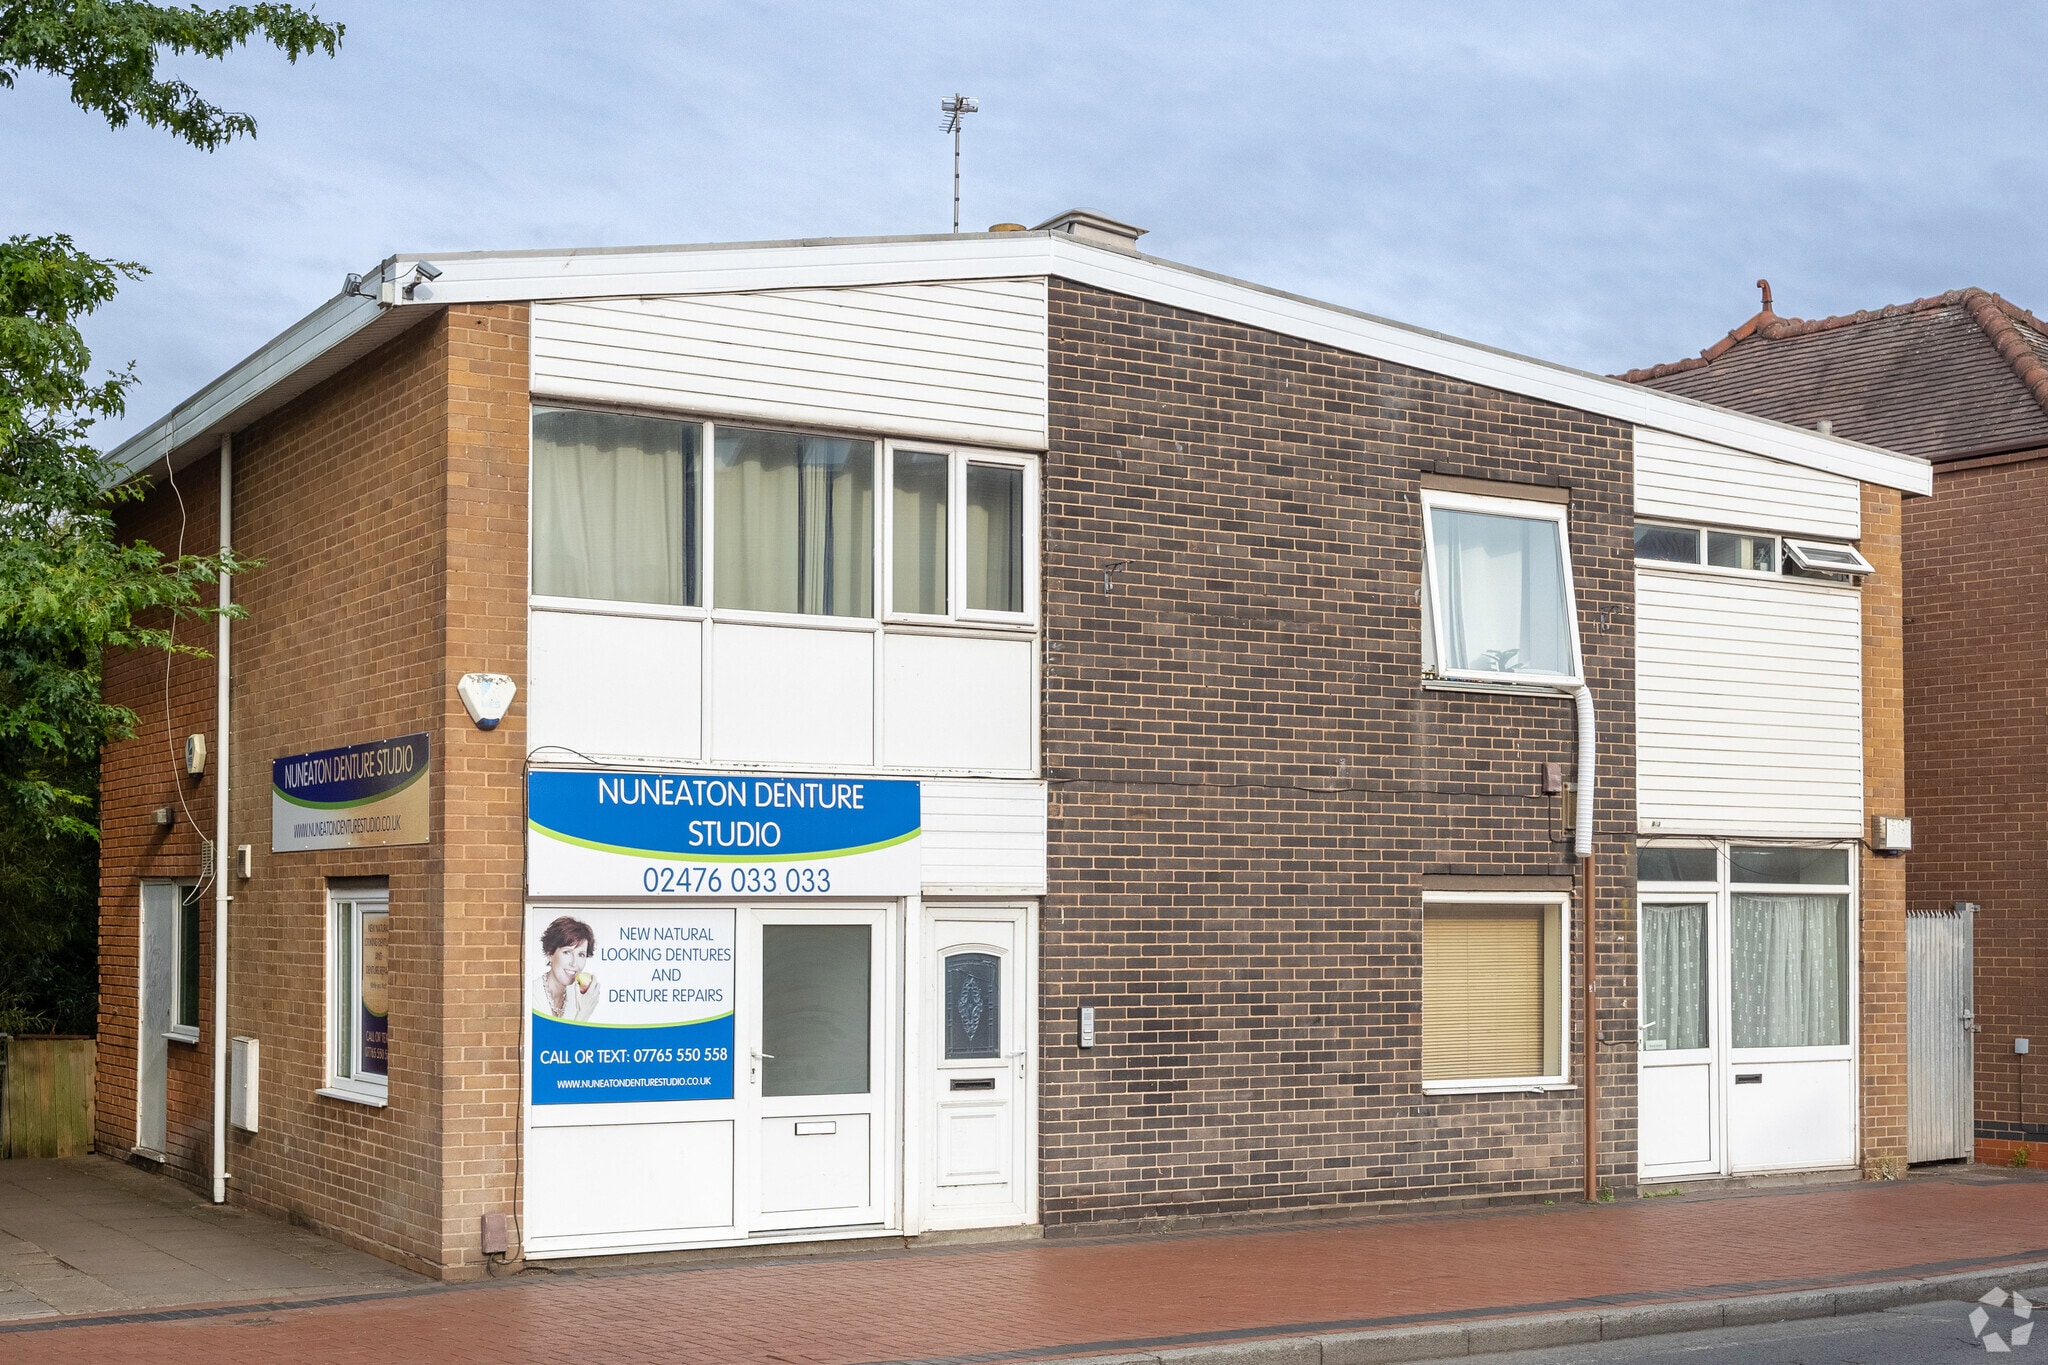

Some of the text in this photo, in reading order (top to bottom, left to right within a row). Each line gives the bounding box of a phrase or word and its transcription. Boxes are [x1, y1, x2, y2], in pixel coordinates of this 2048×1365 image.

[284, 744, 414, 790] NUNEATON DENTURE STUDIO
[599, 777, 864, 810] NUNEATON DENTURE
[293, 815, 401, 838] WWW.NUNEATONDENTURESTUDIO.CO.UK
[688, 820, 781, 847] STUDIO
[643, 867, 831, 893] 02476 033 033
[620, 927, 714, 940] NEW NATURAL
[601, 947, 731, 961] LOOKING DENTURES
[651, 968, 682, 981] AND
[609, 988, 723, 1003] DENTURE REPAIRS
[540, 1047, 728, 1064] CALL OR TEXT: 07765 550 558
[557, 1076, 712, 1089] WWW.NUNEATONDENTURESTUDIO.CO.UK
